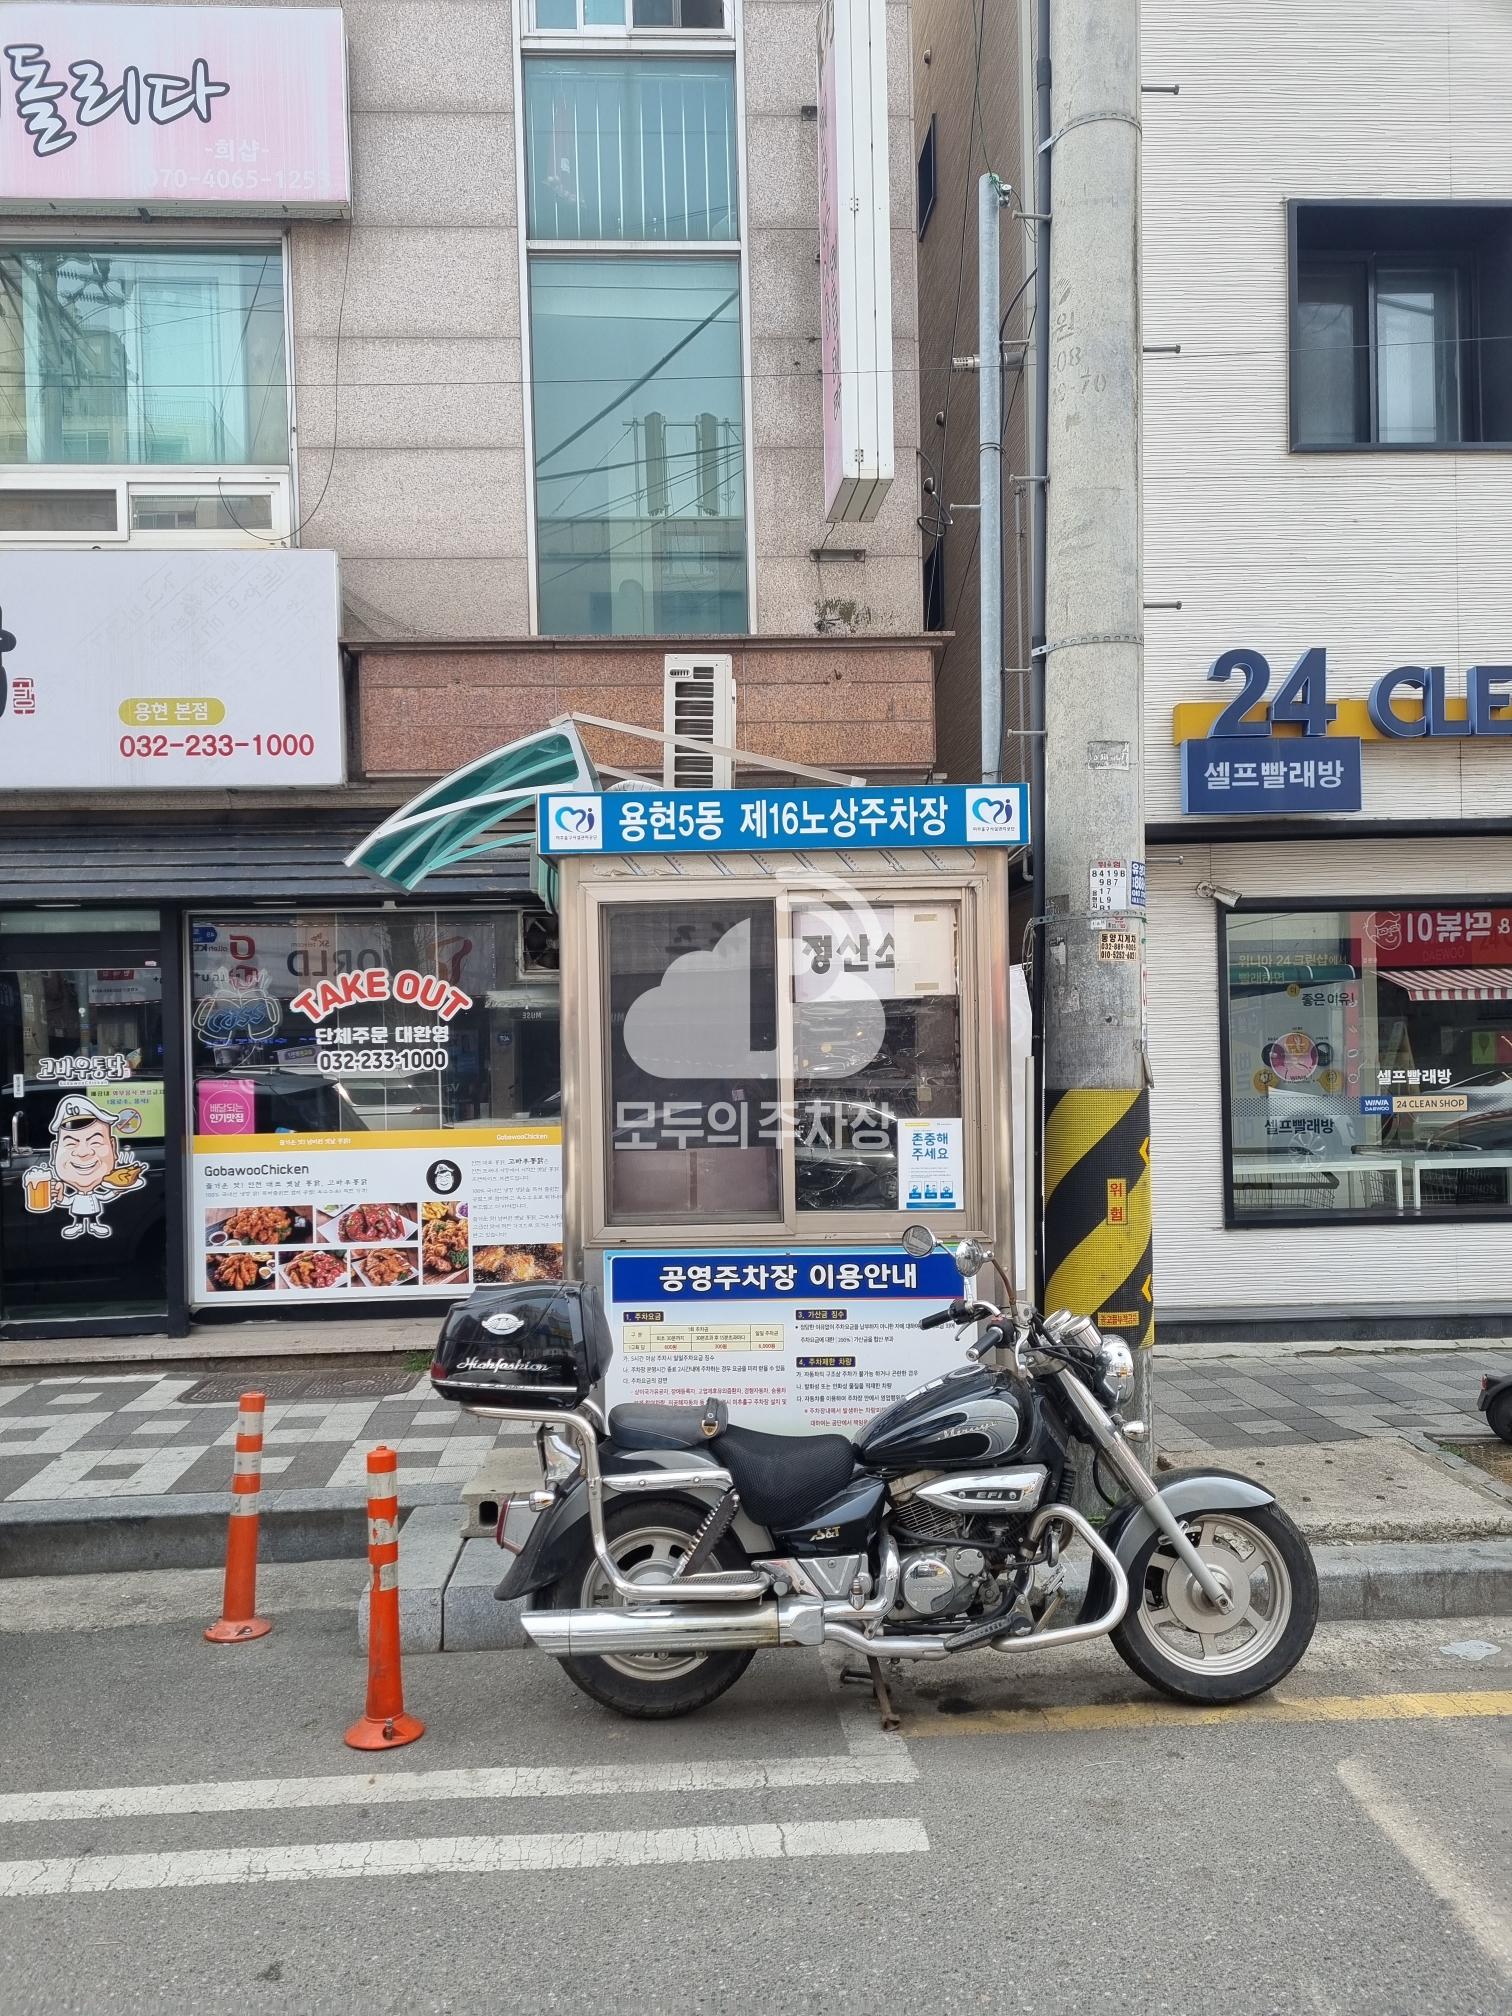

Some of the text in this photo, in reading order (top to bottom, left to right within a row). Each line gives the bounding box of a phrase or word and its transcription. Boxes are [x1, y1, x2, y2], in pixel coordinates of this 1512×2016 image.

[4, 44, 230, 157] 돌리다
[1207, 647, 1337, 739] 24
[133, 701, 208, 721] 용현 본점
[119, 733, 315, 758] 032-233-1000
[1204, 759, 1345, 790] 셀프빨래방
[618, 796, 949, 842] 용현5동 제16노상주차장
[1239, 953, 1273, 967] 위니아
[1276, 954, 1291, 966] 24
[290, 968, 473, 1024] TAKE OUT
[1302, 993, 1325, 1006] 좋은
[315, 1026, 449, 1046] 단체주문 대환영
[37, 1054, 126, 1080] 고바우통닭
[317, 1049, 449, 1074] 032-233-1000
[1377, 1068, 1453, 1085] 셀프빨래방
[66, 1102, 80, 1115] Go
[209, 1103, 244, 1114] 배달되는
[1396, 1100, 1407, 1108] 24
[1409, 1099, 1438, 1108] CLEAN
[1440, 1098, 1465, 1108] SHOP
[209, 1113, 245, 1124] 인기맛집
[1264, 1117, 1335, 1135] 셀프빨래방
[912, 1132, 948, 1146] 존중해
[912, 1147, 949, 1161] 주세요
[204, 1164, 309, 1177] GobawooChicken
[659, 1263, 917, 1292] 공영주차장 이용안내
[635, 1312, 661, 1321] 주차요금
[808, 1311, 828, 1319] 가산금
[809, 1358, 835, 1366] 주차제한
[975, 1490, 1003, 1500] EFI
